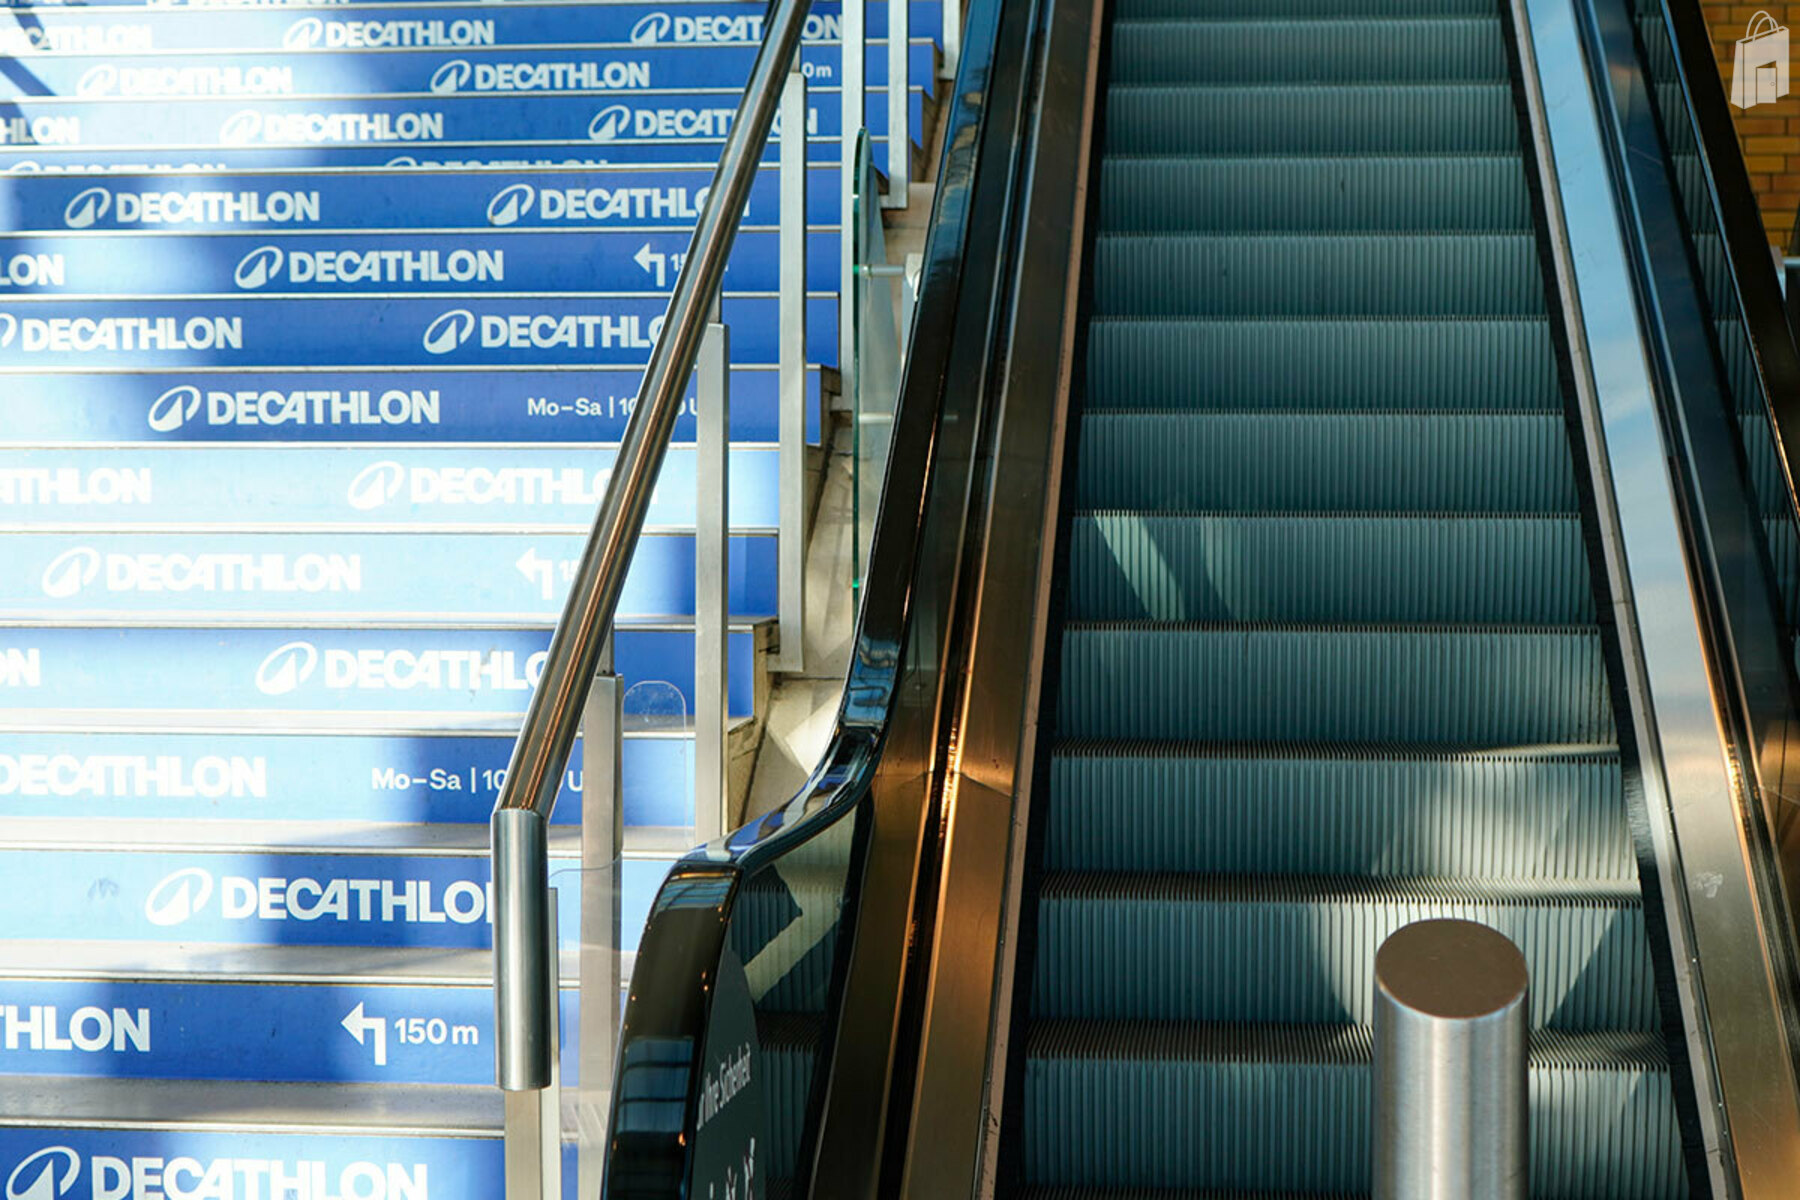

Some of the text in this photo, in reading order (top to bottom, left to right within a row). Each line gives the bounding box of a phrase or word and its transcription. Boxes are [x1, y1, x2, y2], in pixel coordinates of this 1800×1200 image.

[325, 21, 495, 48] DECATHLON
[673, 15, 842, 42] DECATON
[119, 66, 293, 96] DECATHLON
[474, 61, 650, 90] DECATHLON
[263, 113, 443, 143] DECATHLON
[116, 191, 320, 222] DECATHLON
[289, 250, 504, 284] DECATHLON
[22, 317, 243, 352] DECATHLON
[207, 390, 440, 425] DECATHLON
[106, 553, 361, 592] DECATHLON
[221, 877, 491, 924] DECATHLO
[0, 1006, 150, 1052] HLON
[395, 1018, 479, 1045] 150 m
[91, 1155, 428, 1200] DECATHLON
